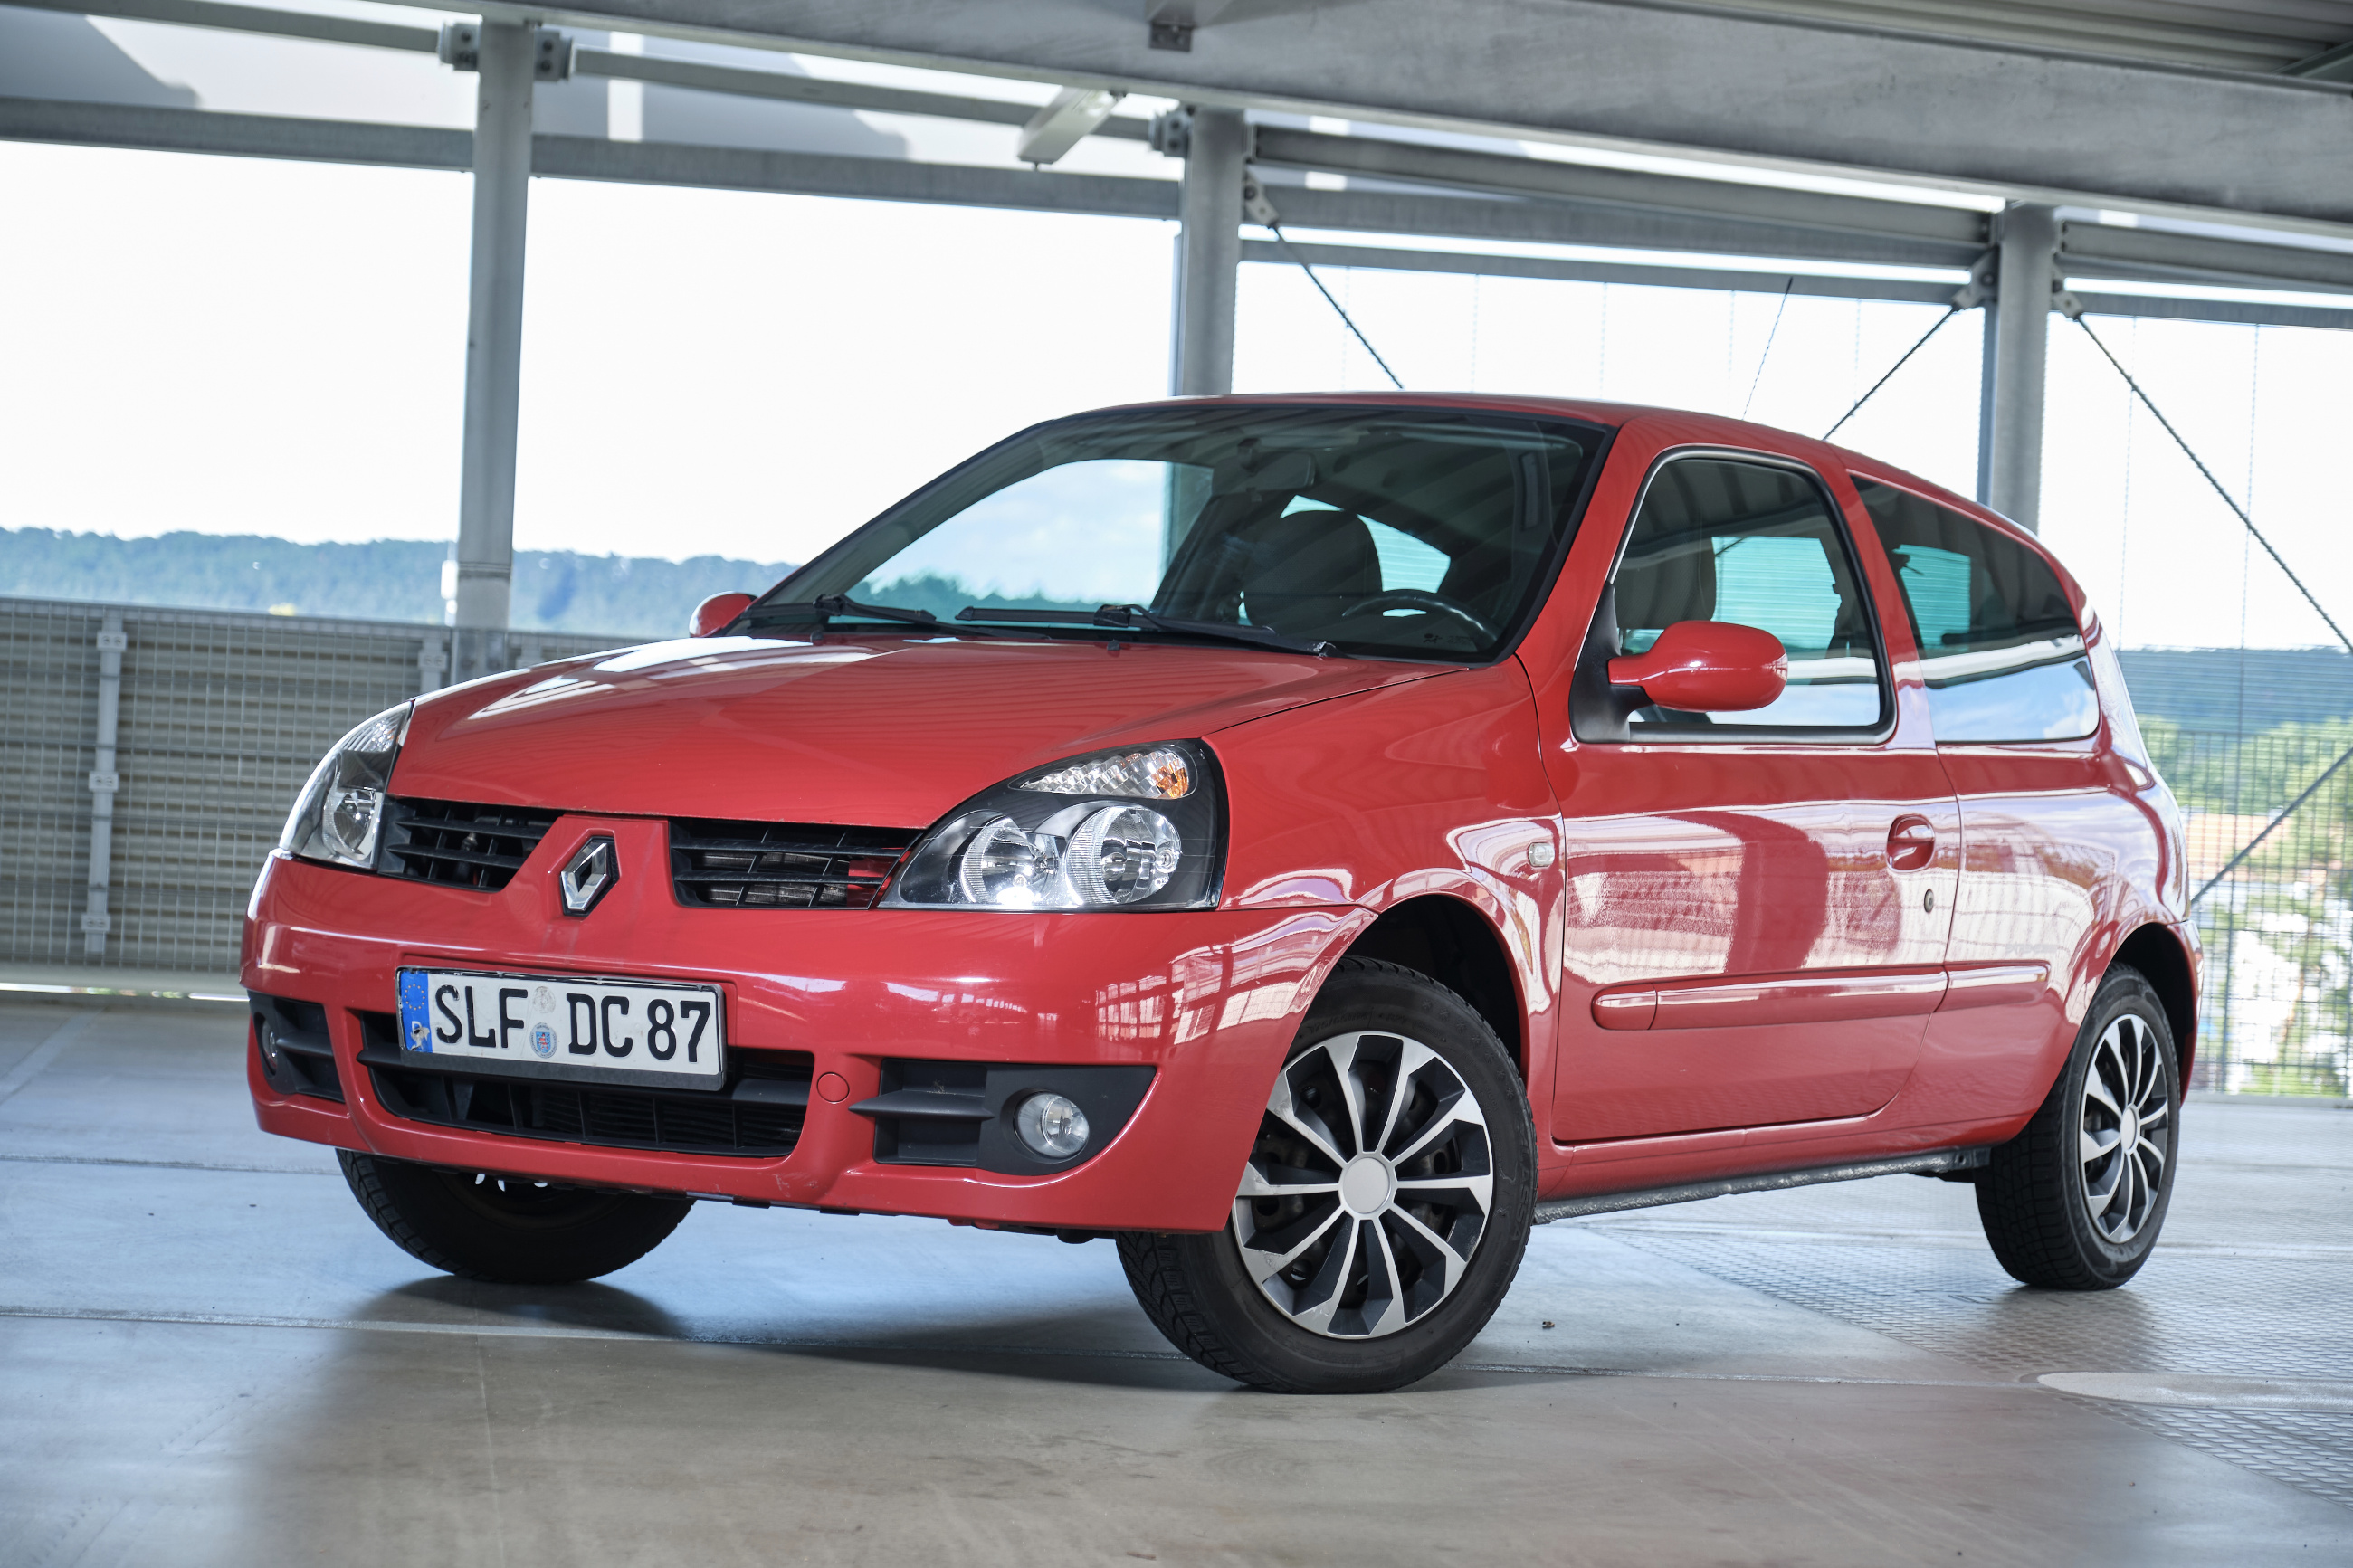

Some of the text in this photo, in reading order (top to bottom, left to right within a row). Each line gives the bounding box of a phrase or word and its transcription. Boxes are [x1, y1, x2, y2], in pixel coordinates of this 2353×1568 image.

[435, 984, 528, 1049] SLF
[566, 993, 633, 1058] DC
[647, 999, 710, 1062] 87
